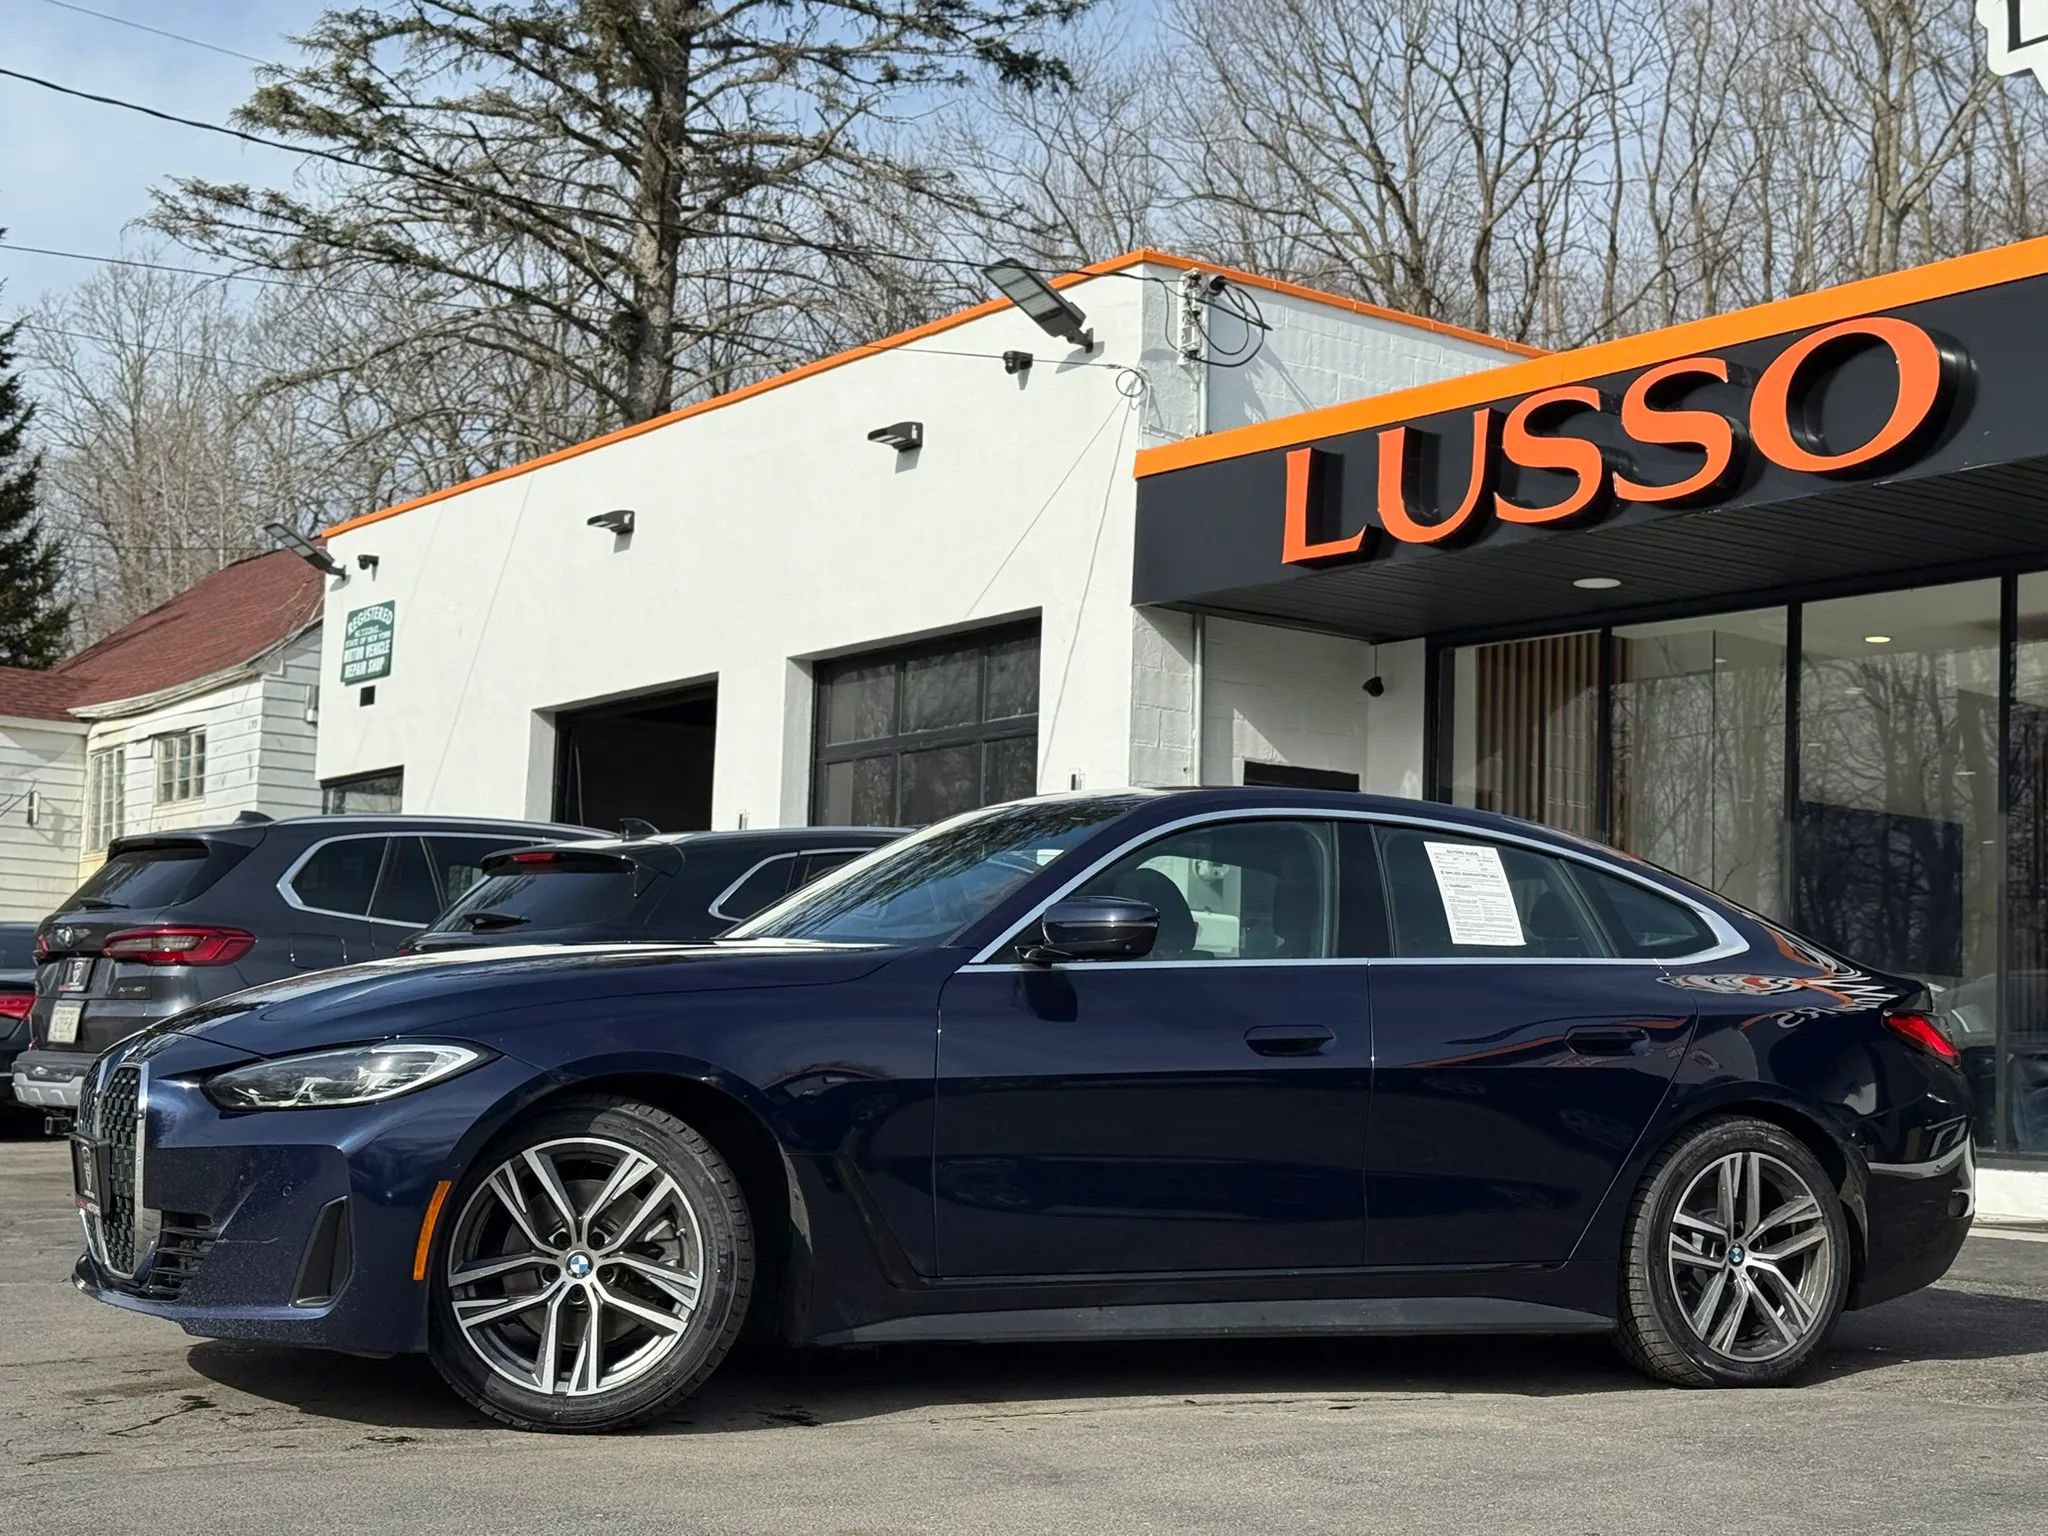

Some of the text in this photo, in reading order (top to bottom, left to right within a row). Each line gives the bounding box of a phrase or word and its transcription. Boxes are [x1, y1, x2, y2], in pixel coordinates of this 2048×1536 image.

[1282, 317, 1941, 565] LUSSO
[347, 606, 393, 636] REGISTERED
[343, 639, 390, 663] MOTOR VEHICLE
[345, 638, 359, 649] STATE
[367, 634, 378, 644] NEW
[344, 656, 385, 678] REPAIR SHOP
